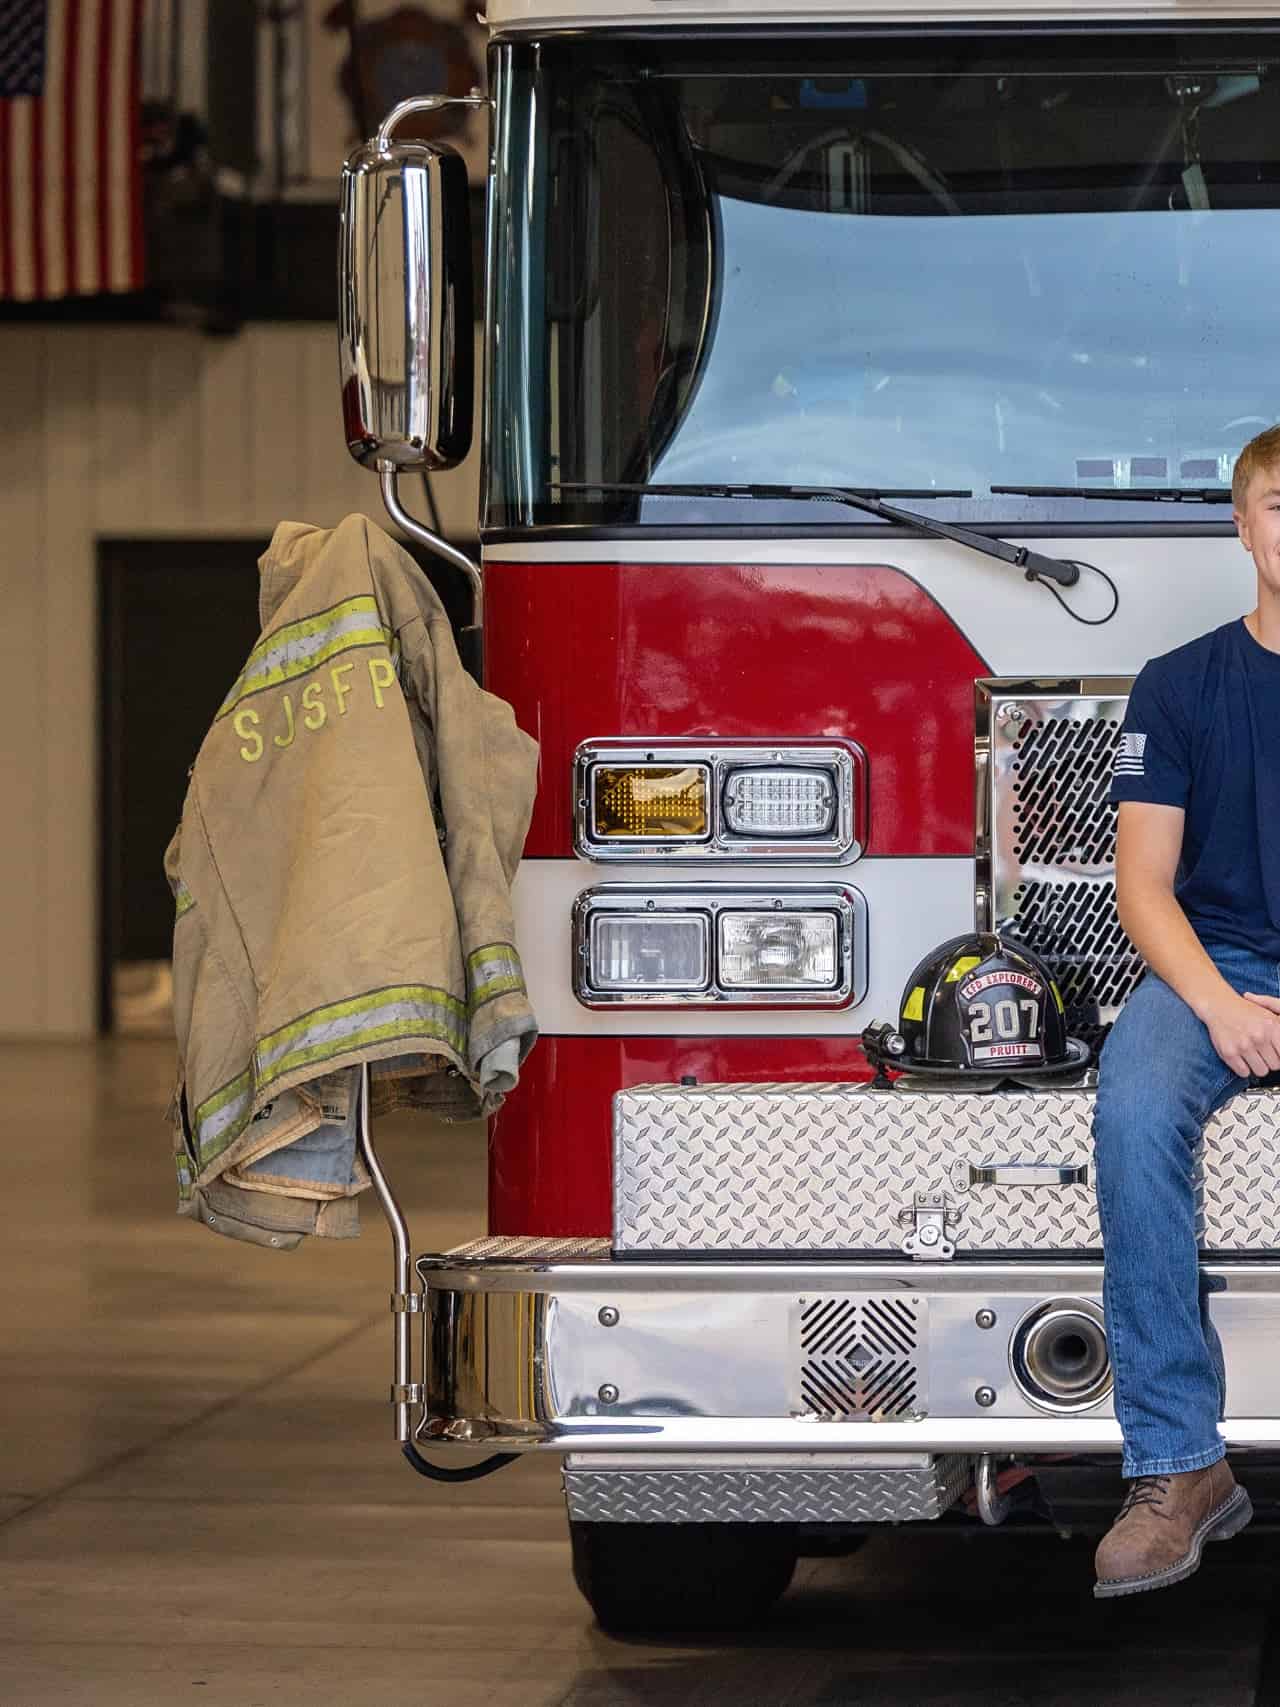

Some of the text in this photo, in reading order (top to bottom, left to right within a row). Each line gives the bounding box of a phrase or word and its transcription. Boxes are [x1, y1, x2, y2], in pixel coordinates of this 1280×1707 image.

[233, 658, 395, 762] SJSFP
[986, 973, 1038, 994] EXPLORERS
[968, 1000, 1039, 1042] 207
[990, 1045, 1027, 1056] PRUITT
